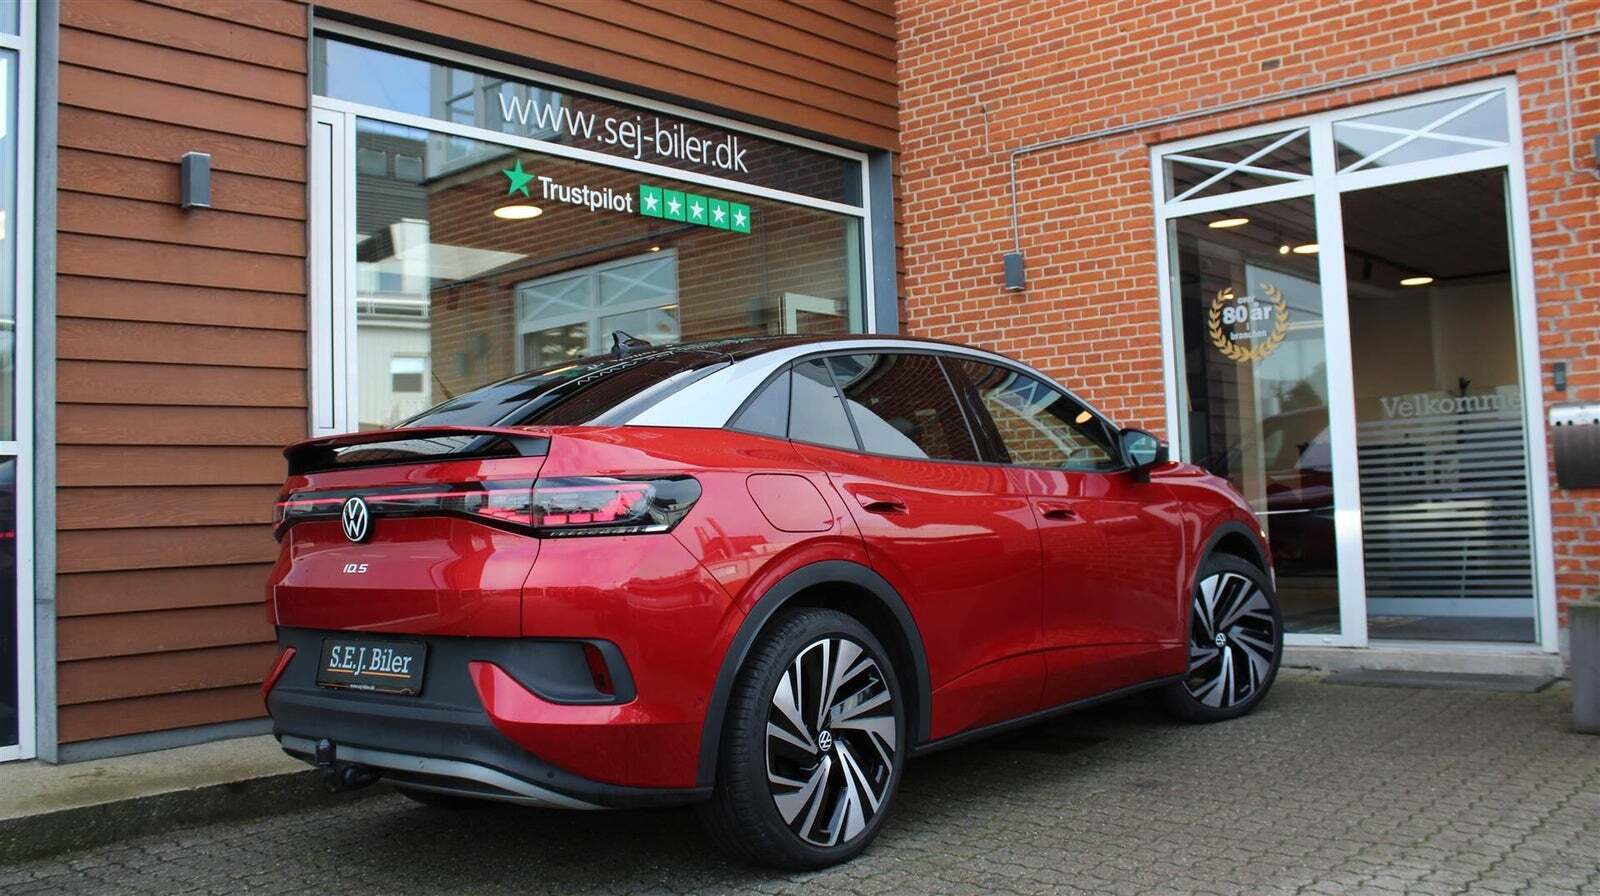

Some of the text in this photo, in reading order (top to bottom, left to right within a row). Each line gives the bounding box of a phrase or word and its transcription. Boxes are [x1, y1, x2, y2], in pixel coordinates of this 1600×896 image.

[498, 92, 748, 173] www.sej-biler.dk
[538, 176, 633, 213] Trustpilot
[1222, 302, 1273, 325] 80 år
[329, 645, 412, 676] S.E.J. Biler
